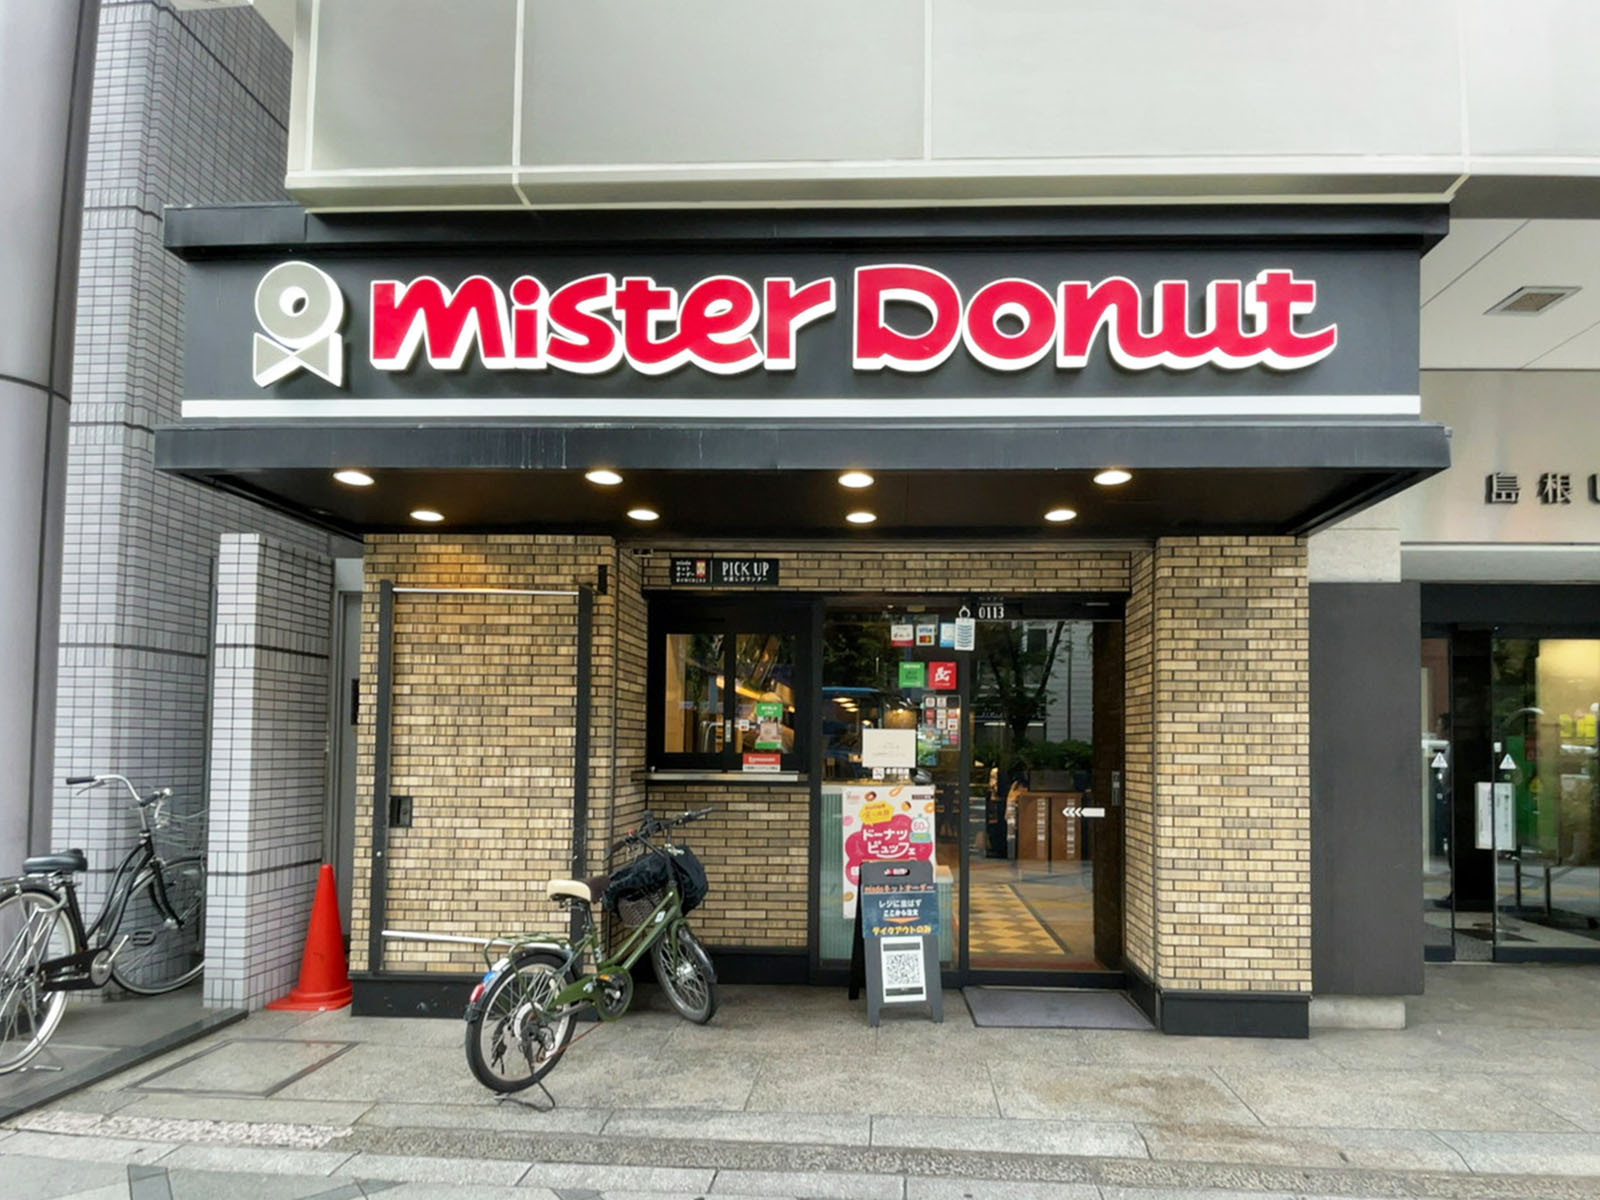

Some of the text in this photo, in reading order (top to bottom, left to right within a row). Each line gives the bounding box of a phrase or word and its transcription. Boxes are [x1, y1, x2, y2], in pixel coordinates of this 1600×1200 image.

[852, 263, 1338, 373] Donut
[722, 561, 770, 576] PICK UP
[978, 606, 1005, 620] 0113
[863, 829, 908, 842] ドーナツ
[867, 840, 917, 859] ビュッフェ
